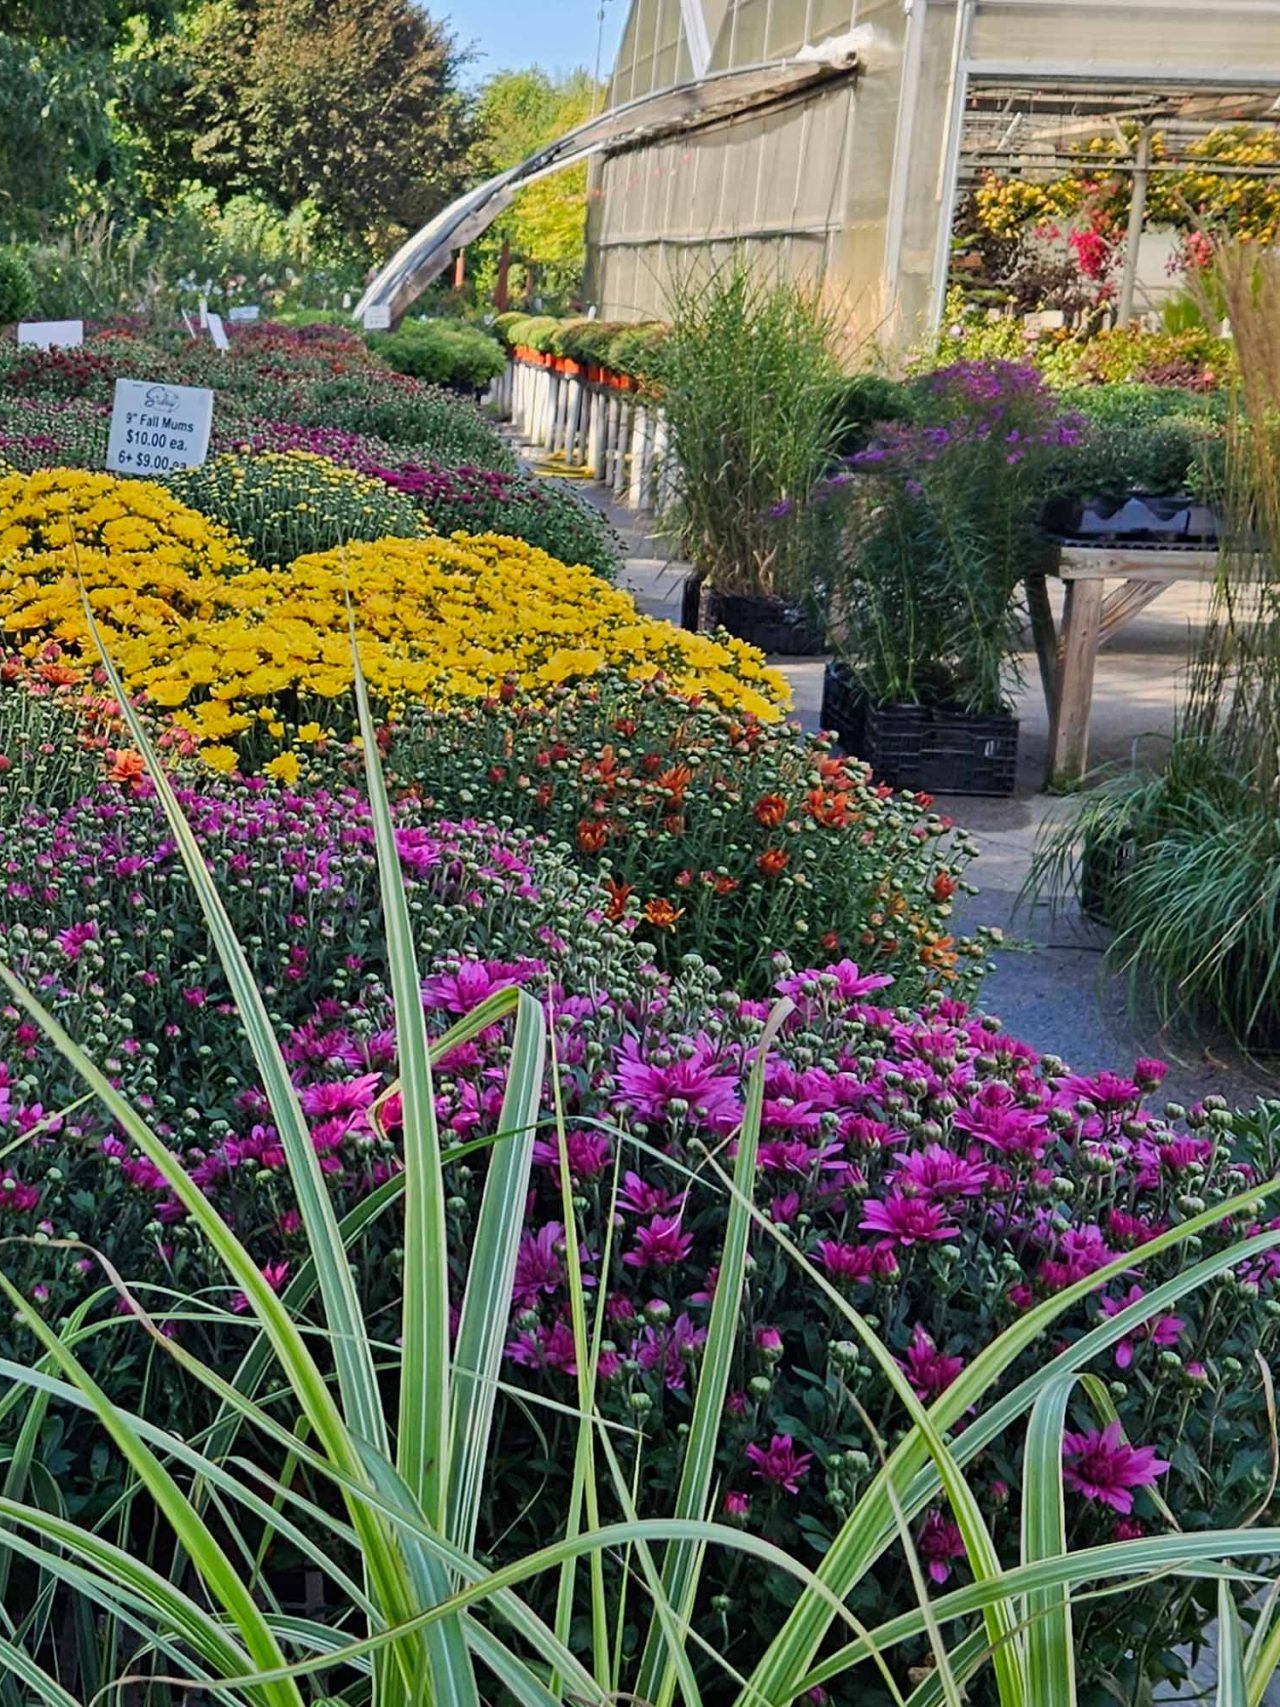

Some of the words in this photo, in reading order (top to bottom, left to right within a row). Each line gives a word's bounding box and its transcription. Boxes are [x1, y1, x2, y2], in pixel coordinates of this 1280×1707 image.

[126, 411, 138, 424] 9"
[140, 414, 160, 428] Fall
[161, 417, 194, 433] Mums
[126, 428, 167, 448] $10.00
[169, 439, 188, 451] ea.
[118, 449, 133, 464] 6+
[136, 452, 169, 470] $9.00
